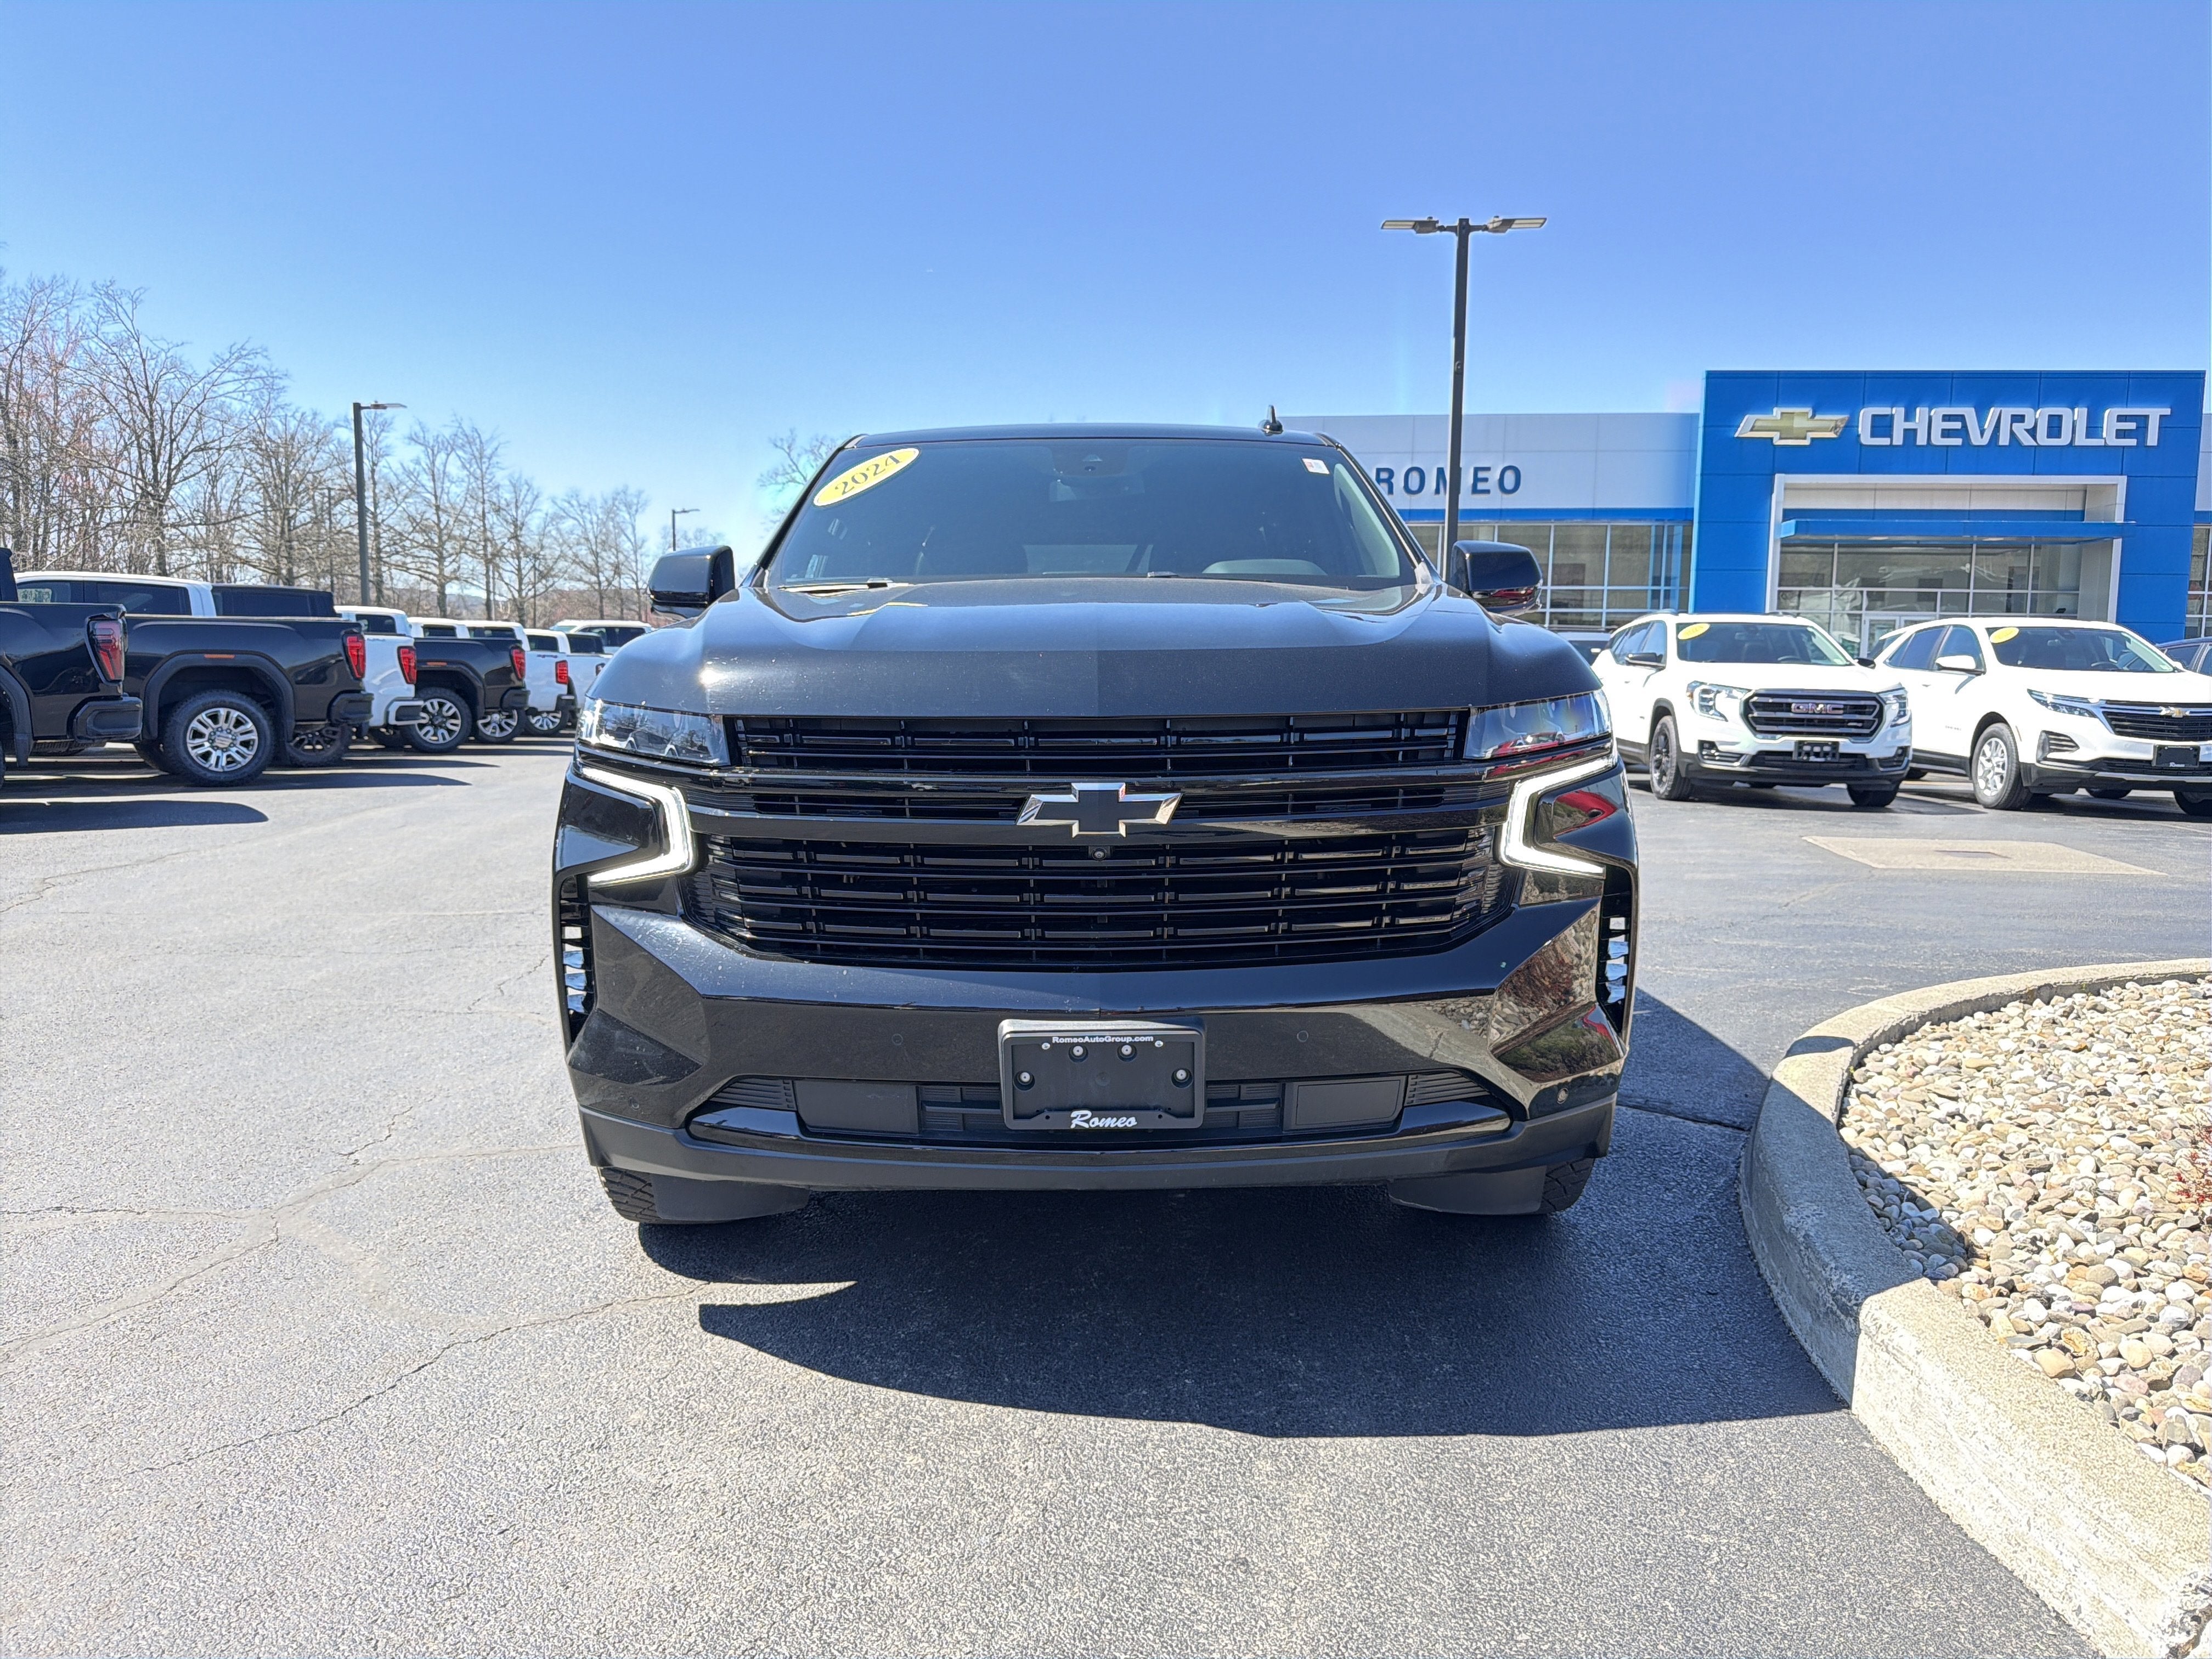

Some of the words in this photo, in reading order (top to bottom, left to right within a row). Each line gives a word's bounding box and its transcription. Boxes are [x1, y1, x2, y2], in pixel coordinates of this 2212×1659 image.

[1858, 407, 2171, 447] CHEVROLET
[834, 455, 902, 495] 2024
[1791, 703, 1844, 714] GMC
[1052, 1035, 1154, 1043] RomeoAutoGroup.com
[1070, 1110, 1137, 1129] Romeo
